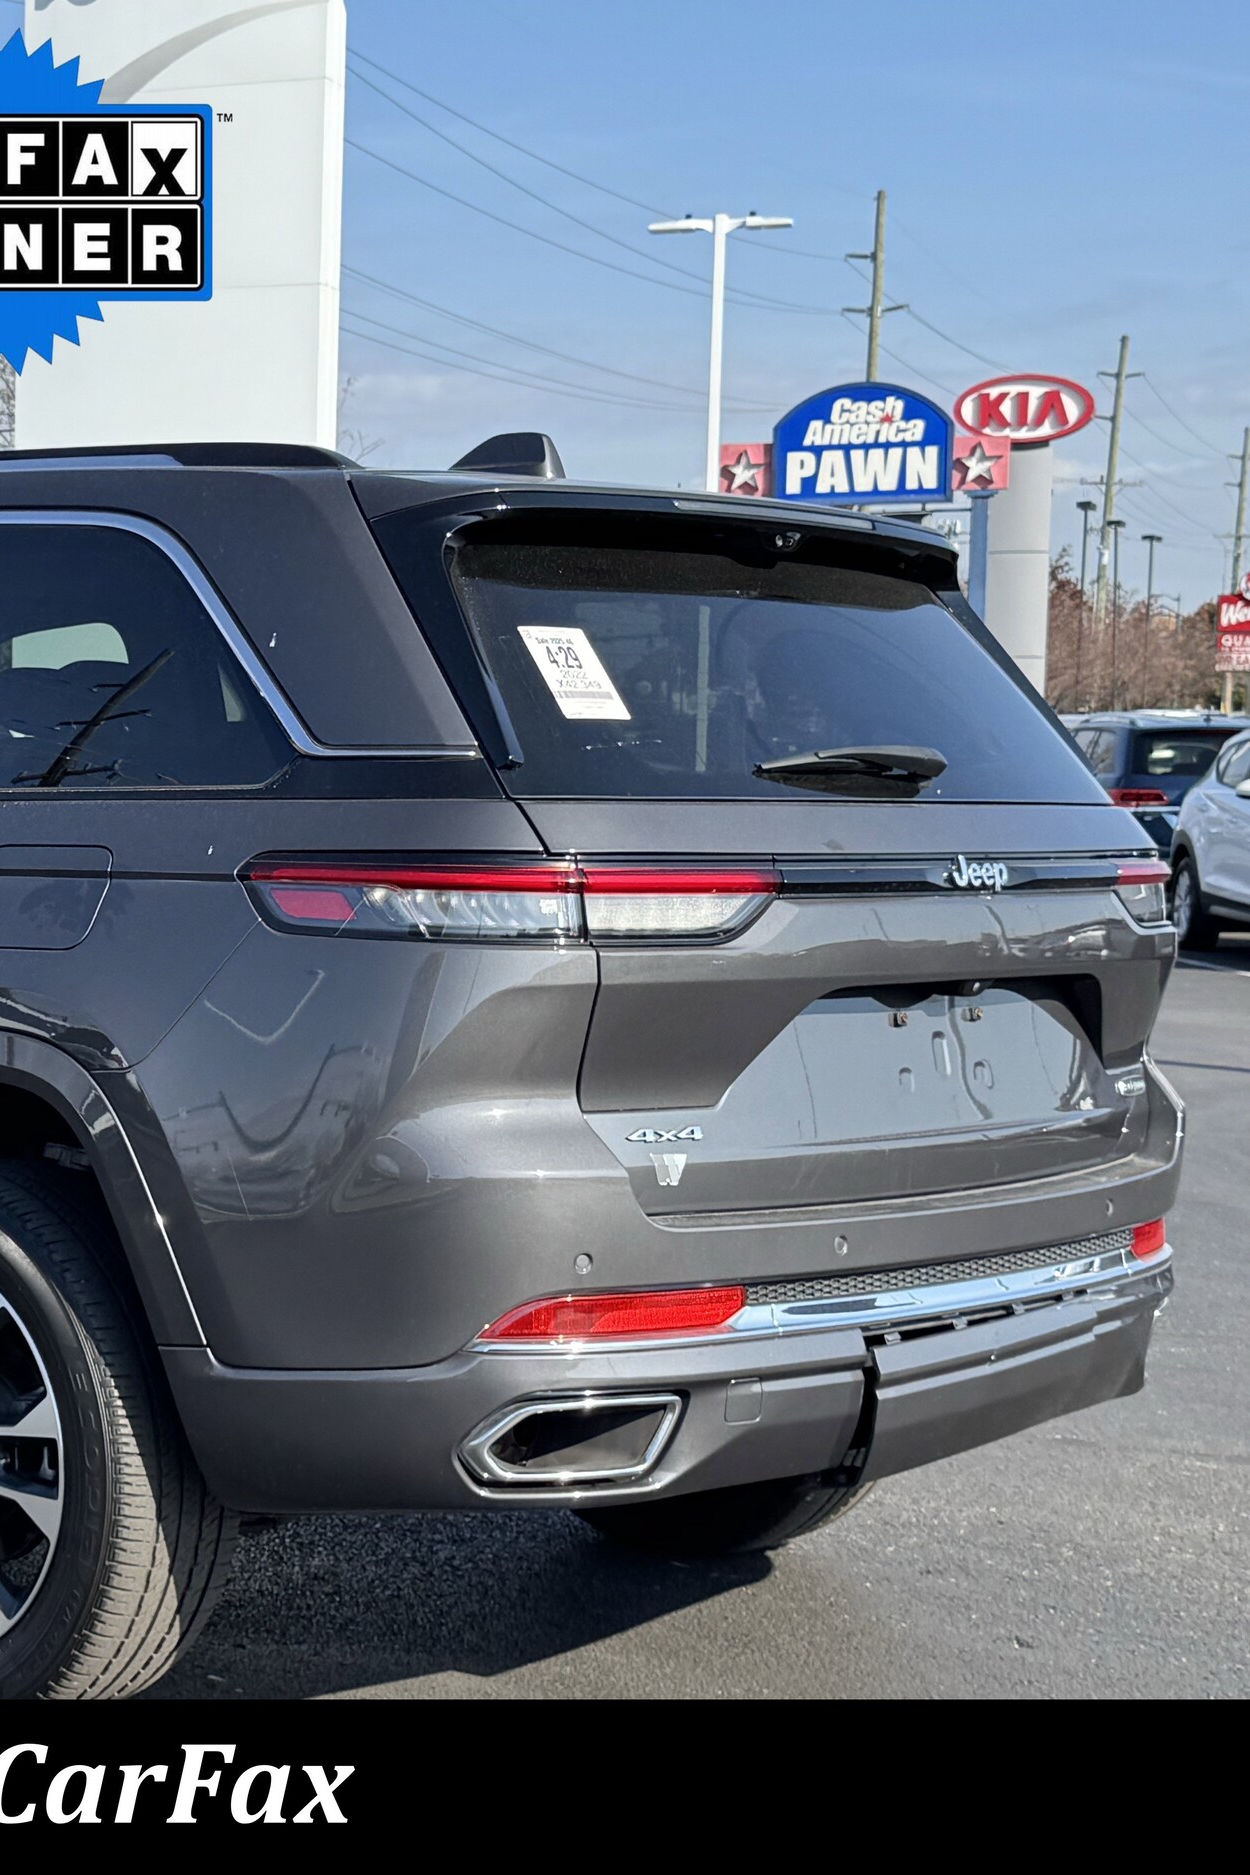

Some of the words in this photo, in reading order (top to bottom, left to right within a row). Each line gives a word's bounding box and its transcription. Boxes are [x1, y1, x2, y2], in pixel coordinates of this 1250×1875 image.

[831, 396, 904, 424] Cash
[973, 390, 1070, 430] KIA
[803, 418, 925, 446] America
[785, 445, 938, 495] PAWN
[952, 854, 1009, 892] Jeep
[624, 1125, 704, 1143] 4x4
